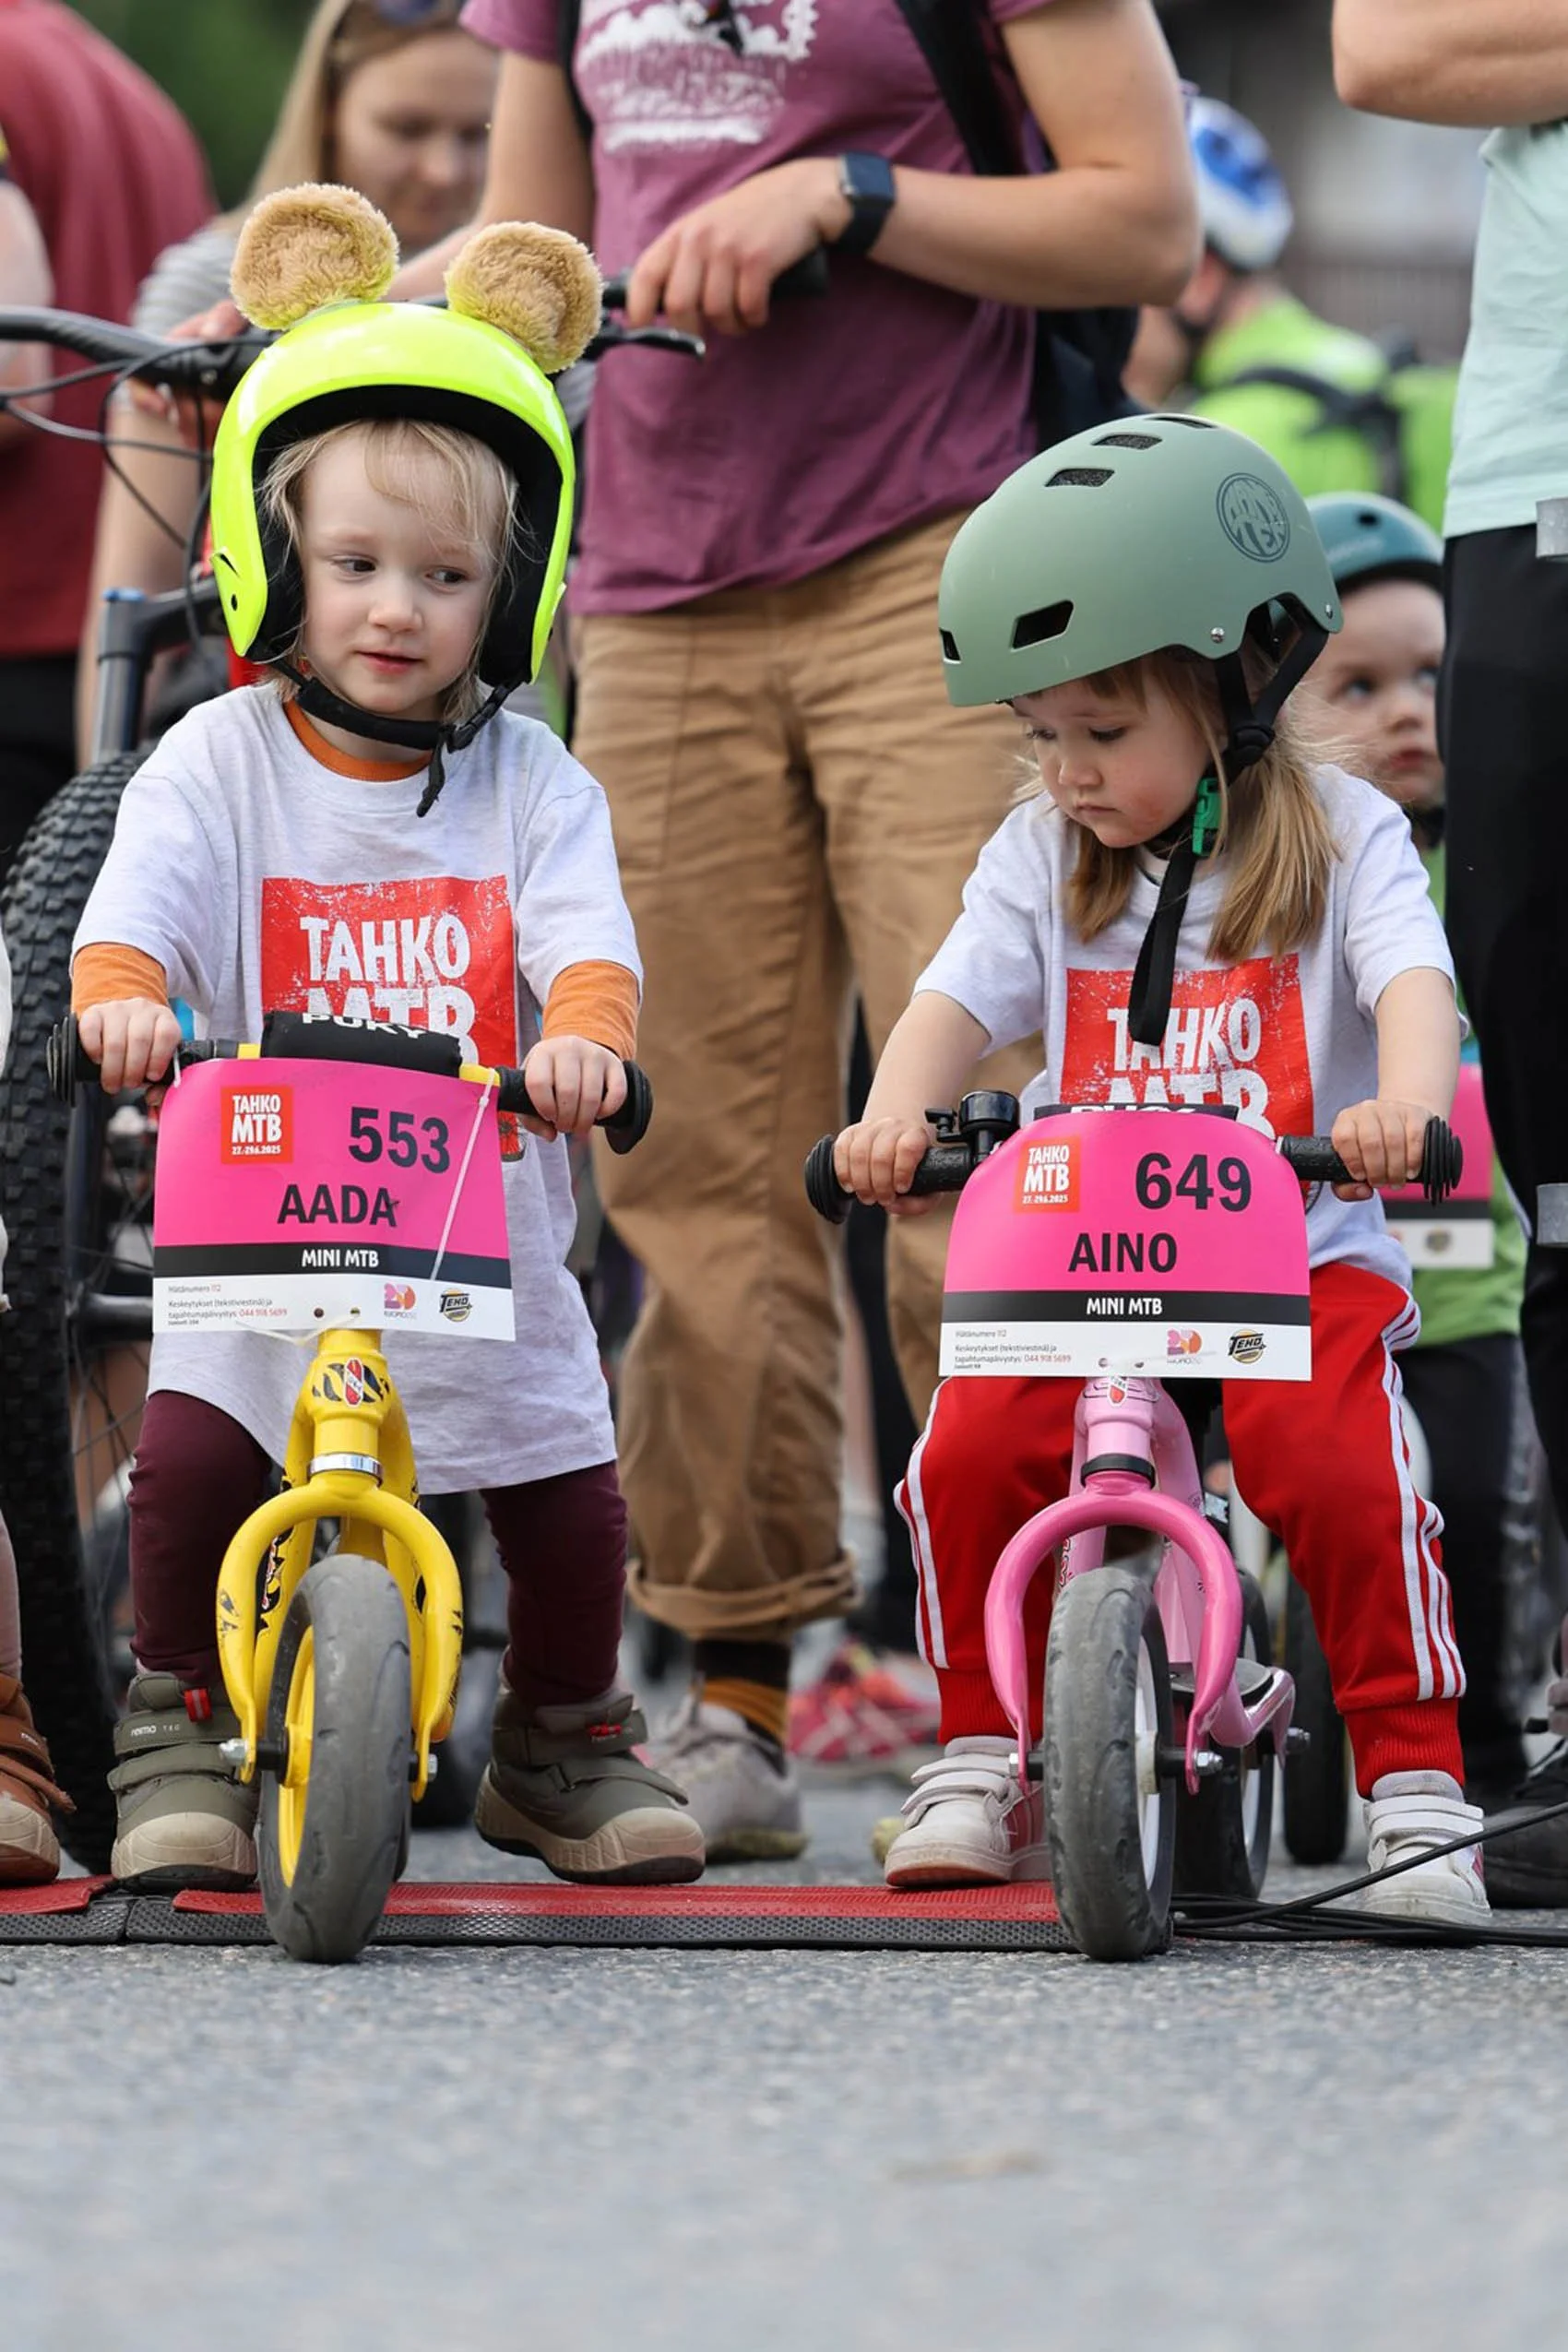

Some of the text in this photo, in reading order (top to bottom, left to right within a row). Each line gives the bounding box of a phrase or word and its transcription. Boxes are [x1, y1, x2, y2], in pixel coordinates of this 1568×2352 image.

[300, 911, 471, 982] TAHKO
[232, 1094, 281, 1113] TAHKO
[232, 1114, 282, 1143] MTB
[348, 1106, 450, 1173] 553
[1028, 1145, 1070, 1164] TAHKO
[1023, 1164, 1070, 1194] MTB
[1135, 1152, 1252, 1212] 649
[277, 1184, 398, 1228] AADA
[302, 1249, 379, 1268] MINI MTB
[1068, 1232, 1177, 1273] AINO
[1087, 1298, 1162, 1314] MINI MTB
